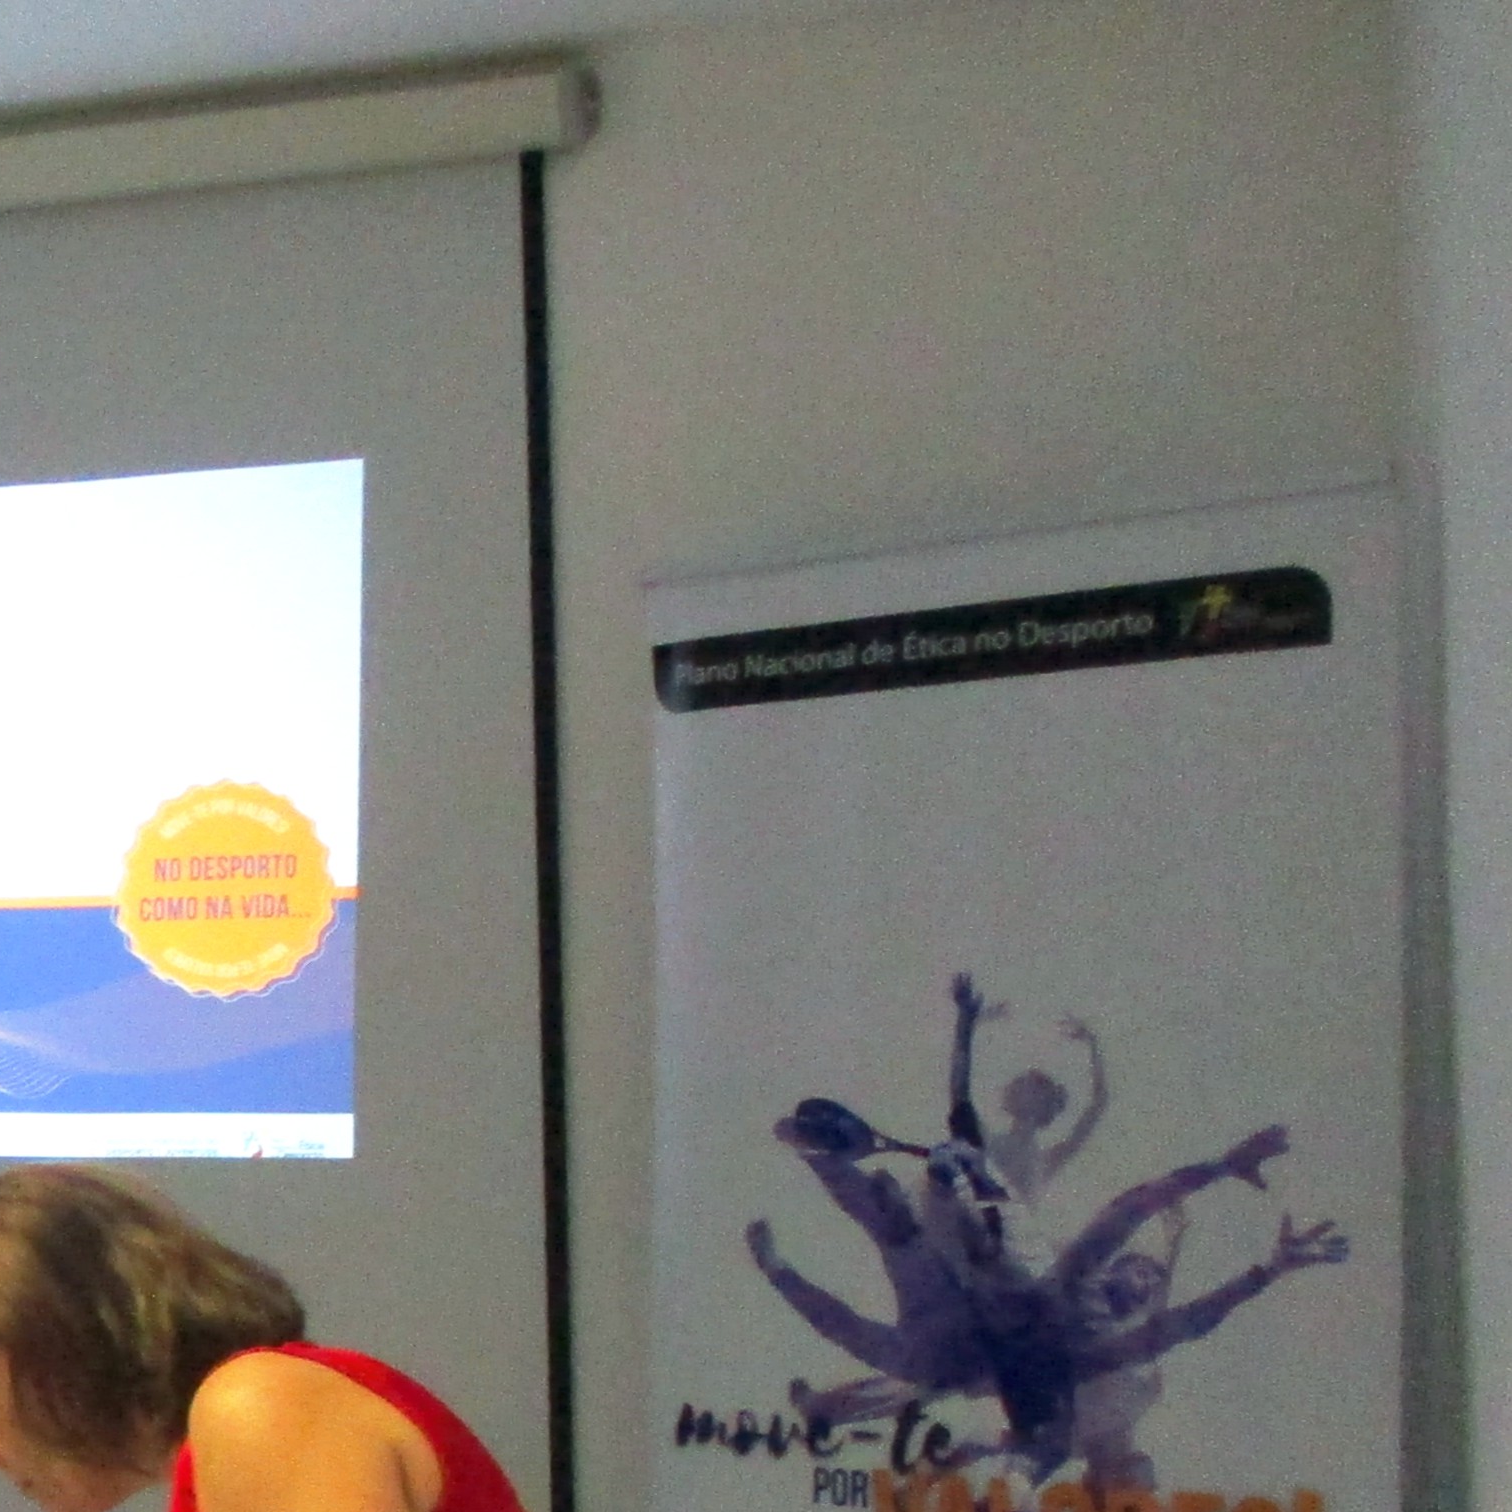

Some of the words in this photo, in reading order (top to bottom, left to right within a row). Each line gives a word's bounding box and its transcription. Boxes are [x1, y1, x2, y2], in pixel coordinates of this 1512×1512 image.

[744, 642, 858, 679] Nacional
[862, 641, 894, 664] de
[903, 631, 967, 660] Ética
[976, 631, 1011, 650] no
[1019, 614, 1155, 649] Desporto
[154, 858, 182, 882] NO
[189, 854, 298, 881] DESPORTO
[139, 897, 199, 922] COMO
[205, 895, 233, 919] NA
[242, 893, 312, 919] VIDA...
[674, 1399, 953, 1476] move-te
[813, 1467, 869, 1509] POR
